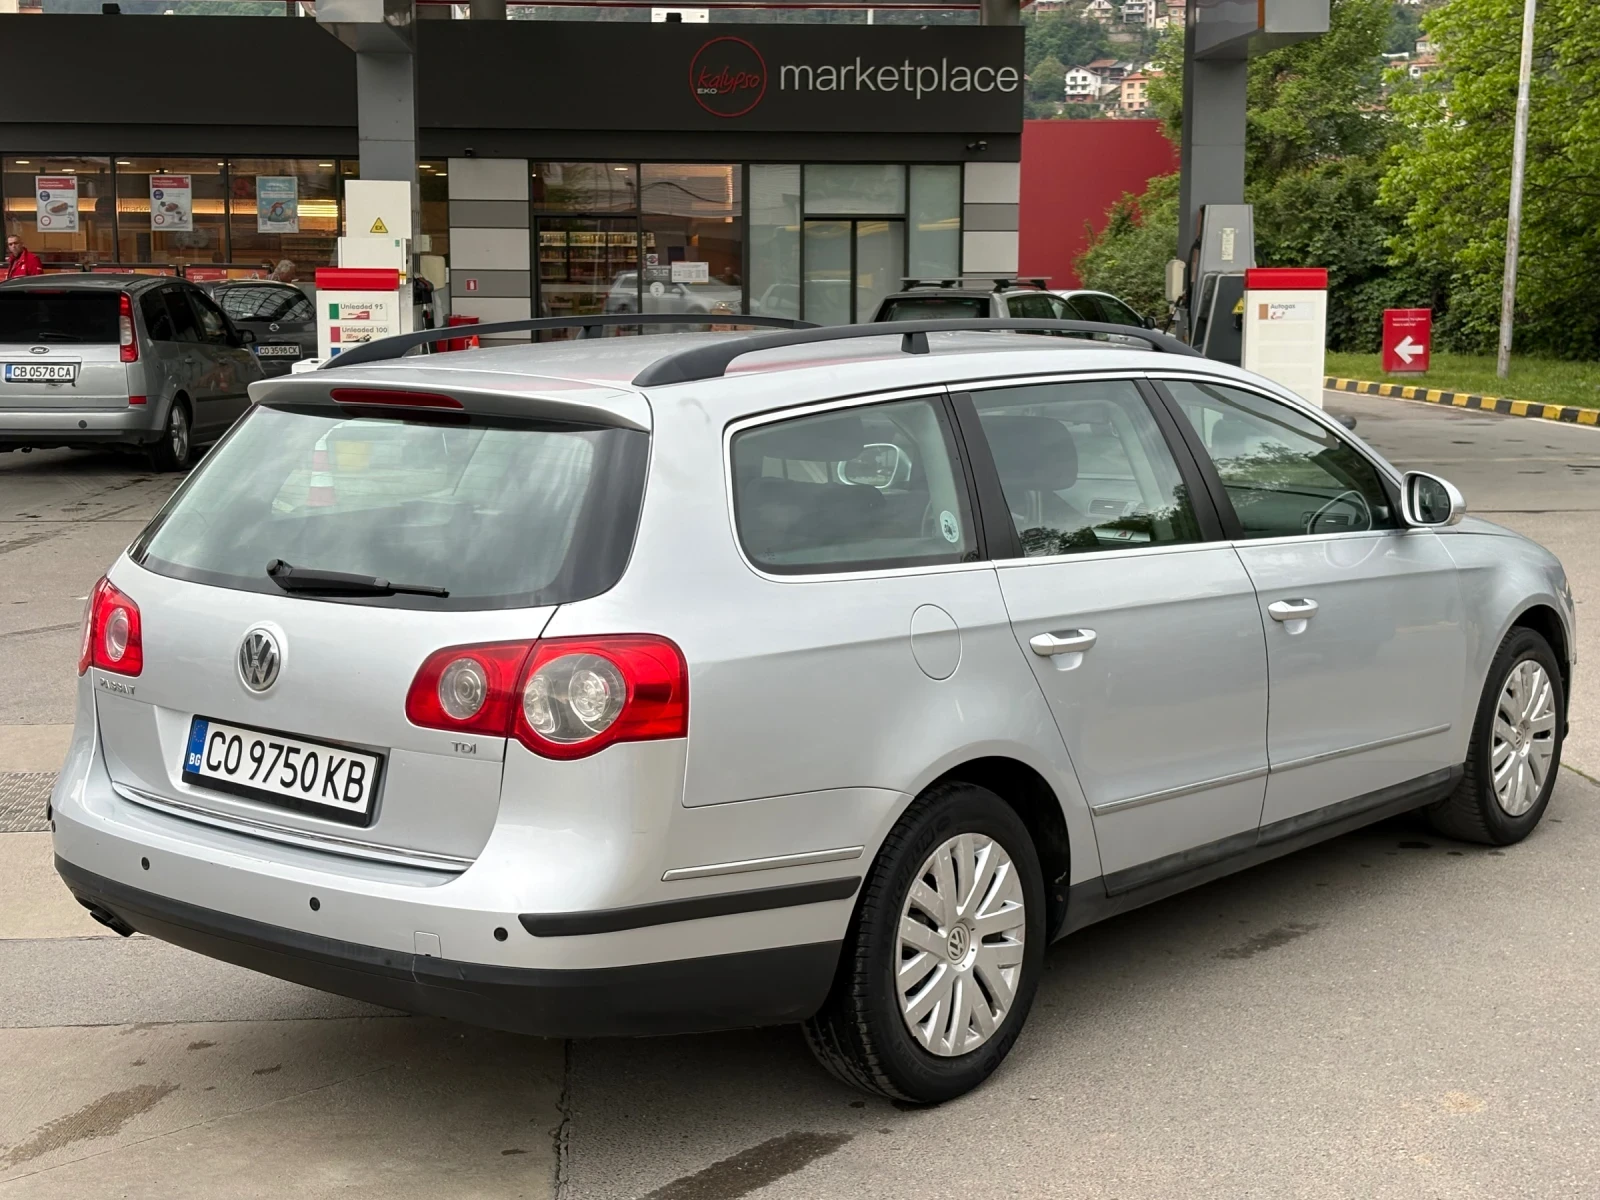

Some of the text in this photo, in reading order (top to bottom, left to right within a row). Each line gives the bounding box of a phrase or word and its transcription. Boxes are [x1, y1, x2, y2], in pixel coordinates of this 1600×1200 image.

[697, 65, 761, 94] kalypso
[780, 56, 1019, 100] marketplace
[13, 366, 72, 378] CB 0578 CA
[99, 676, 136, 695] PASSAT
[450, 740, 477, 755] TDI
[188, 752, 202, 767] BG
[206, 731, 367, 804] CO 9750 KB
